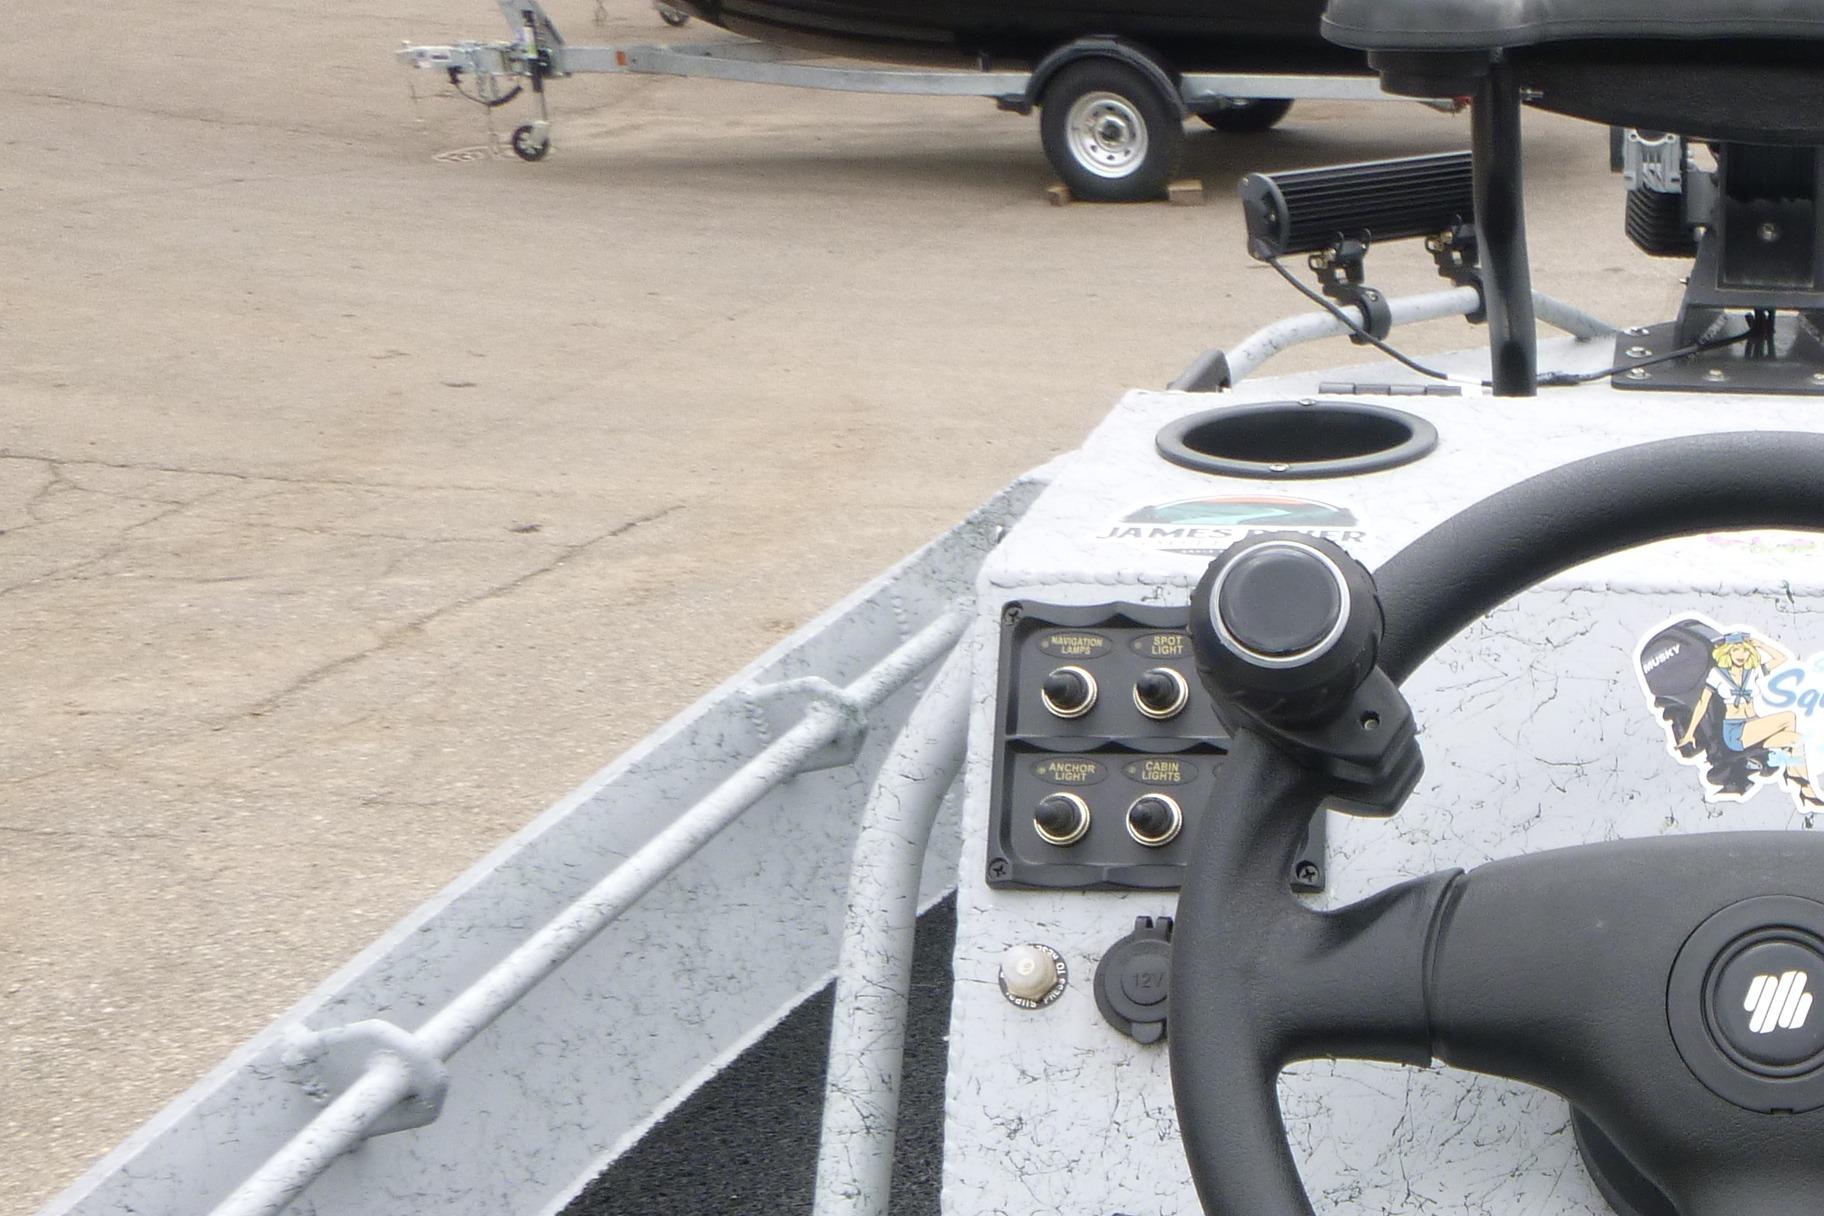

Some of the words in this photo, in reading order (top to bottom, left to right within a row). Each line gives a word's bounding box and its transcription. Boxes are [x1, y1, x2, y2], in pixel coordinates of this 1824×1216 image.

[1095, 527, 1233, 540] JAMES
[1051, 635, 1104, 647] NAVIGATION
[1153, 635, 1182, 646] SPOT
[1061, 646, 1091, 656] LAMPS
[1151, 646, 1184, 656] LIGHT
[1643, 643, 1682, 674] MUSKY
[1049, 762, 1096, 773] ANCHOR
[1145, 761, 1180, 772] CABIN
[1055, 772, 1088, 782] LIGHT
[1141, 771, 1181, 782] LIGHTS
